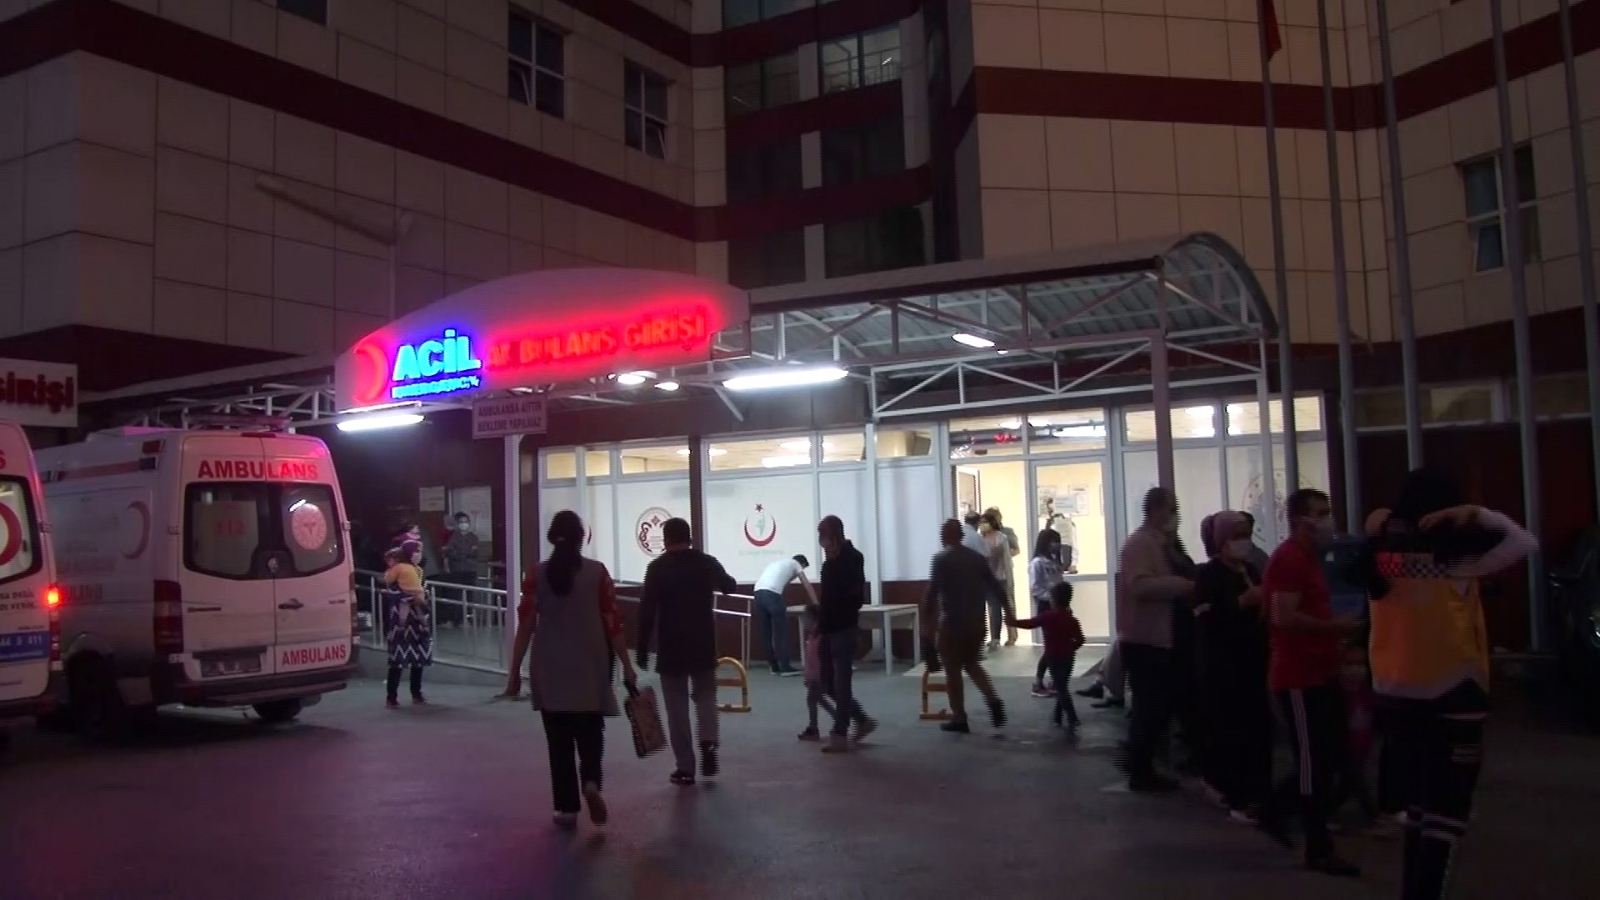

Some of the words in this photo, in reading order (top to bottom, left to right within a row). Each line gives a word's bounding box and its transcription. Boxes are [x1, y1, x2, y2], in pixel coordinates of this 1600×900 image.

[392, 329, 482, 381] ACİL
[197, 460, 318, 480] AMBULANS
[282, 644, 346, 666] AMBULANS
